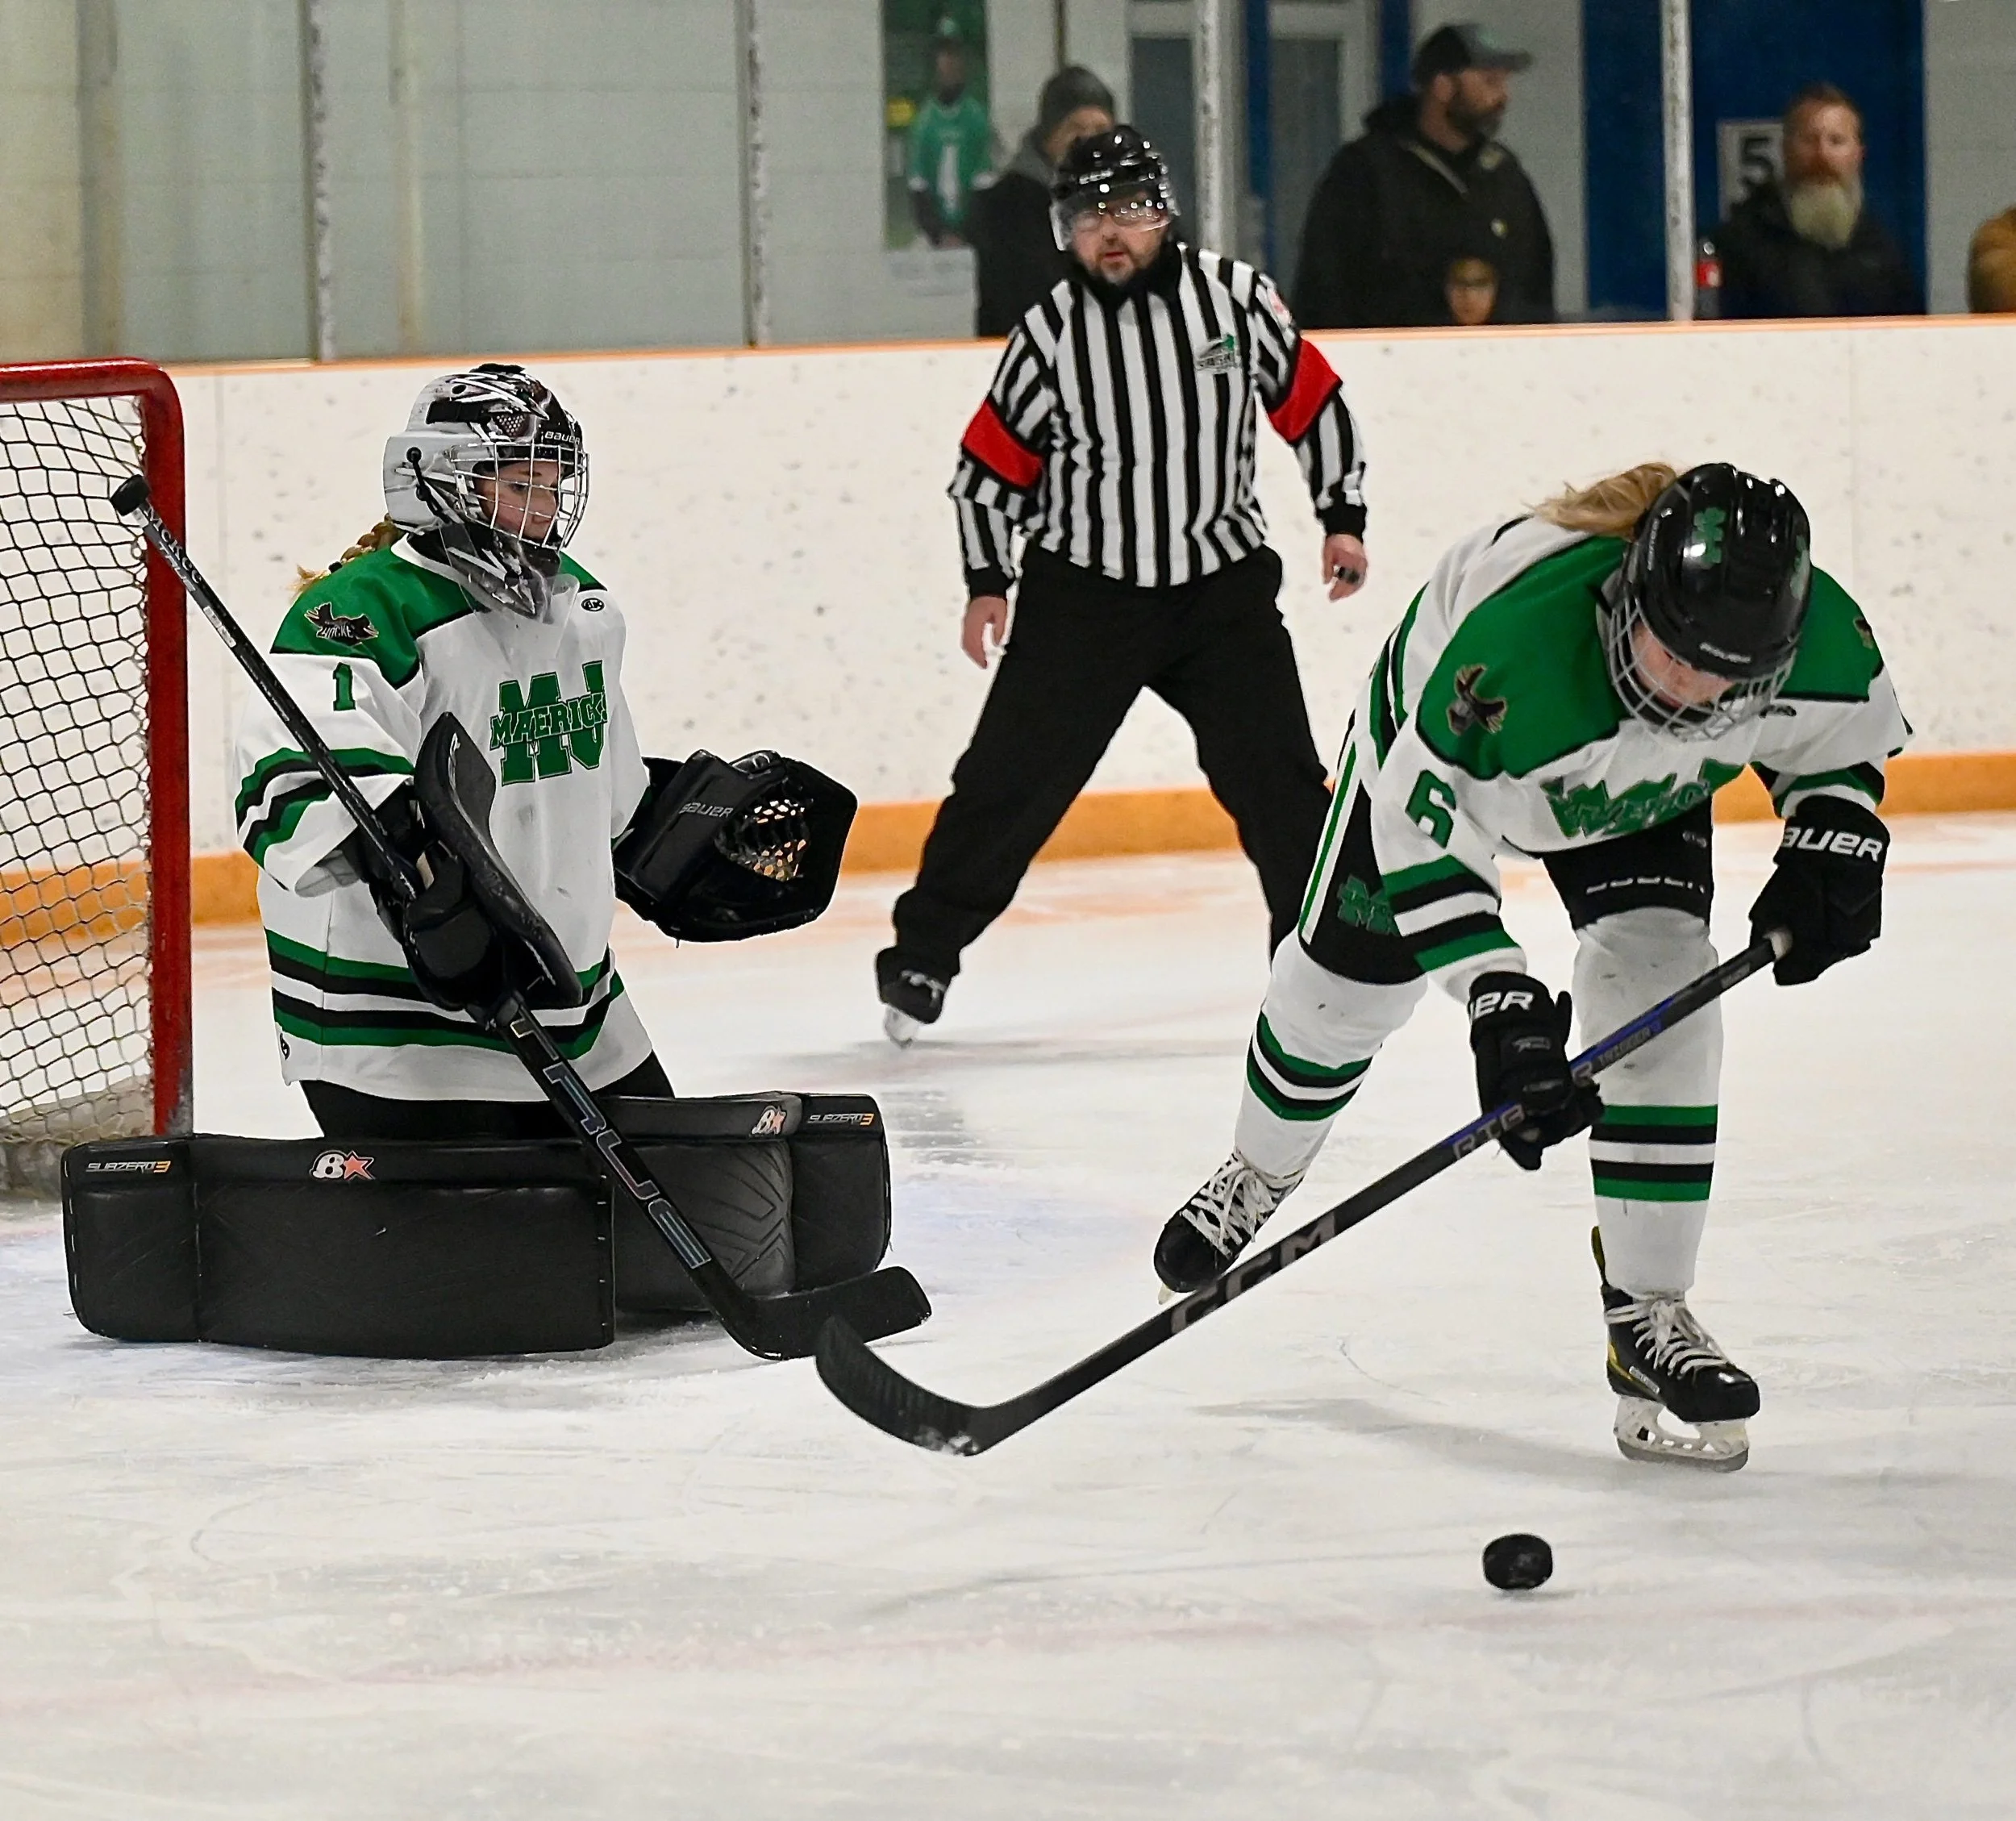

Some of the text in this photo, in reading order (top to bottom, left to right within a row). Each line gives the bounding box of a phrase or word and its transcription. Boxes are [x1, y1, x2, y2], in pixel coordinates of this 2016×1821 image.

[332, 661, 356, 711] 1
[1780, 826, 1884, 863] AUER
[510, 1004, 712, 1269] TRUE
